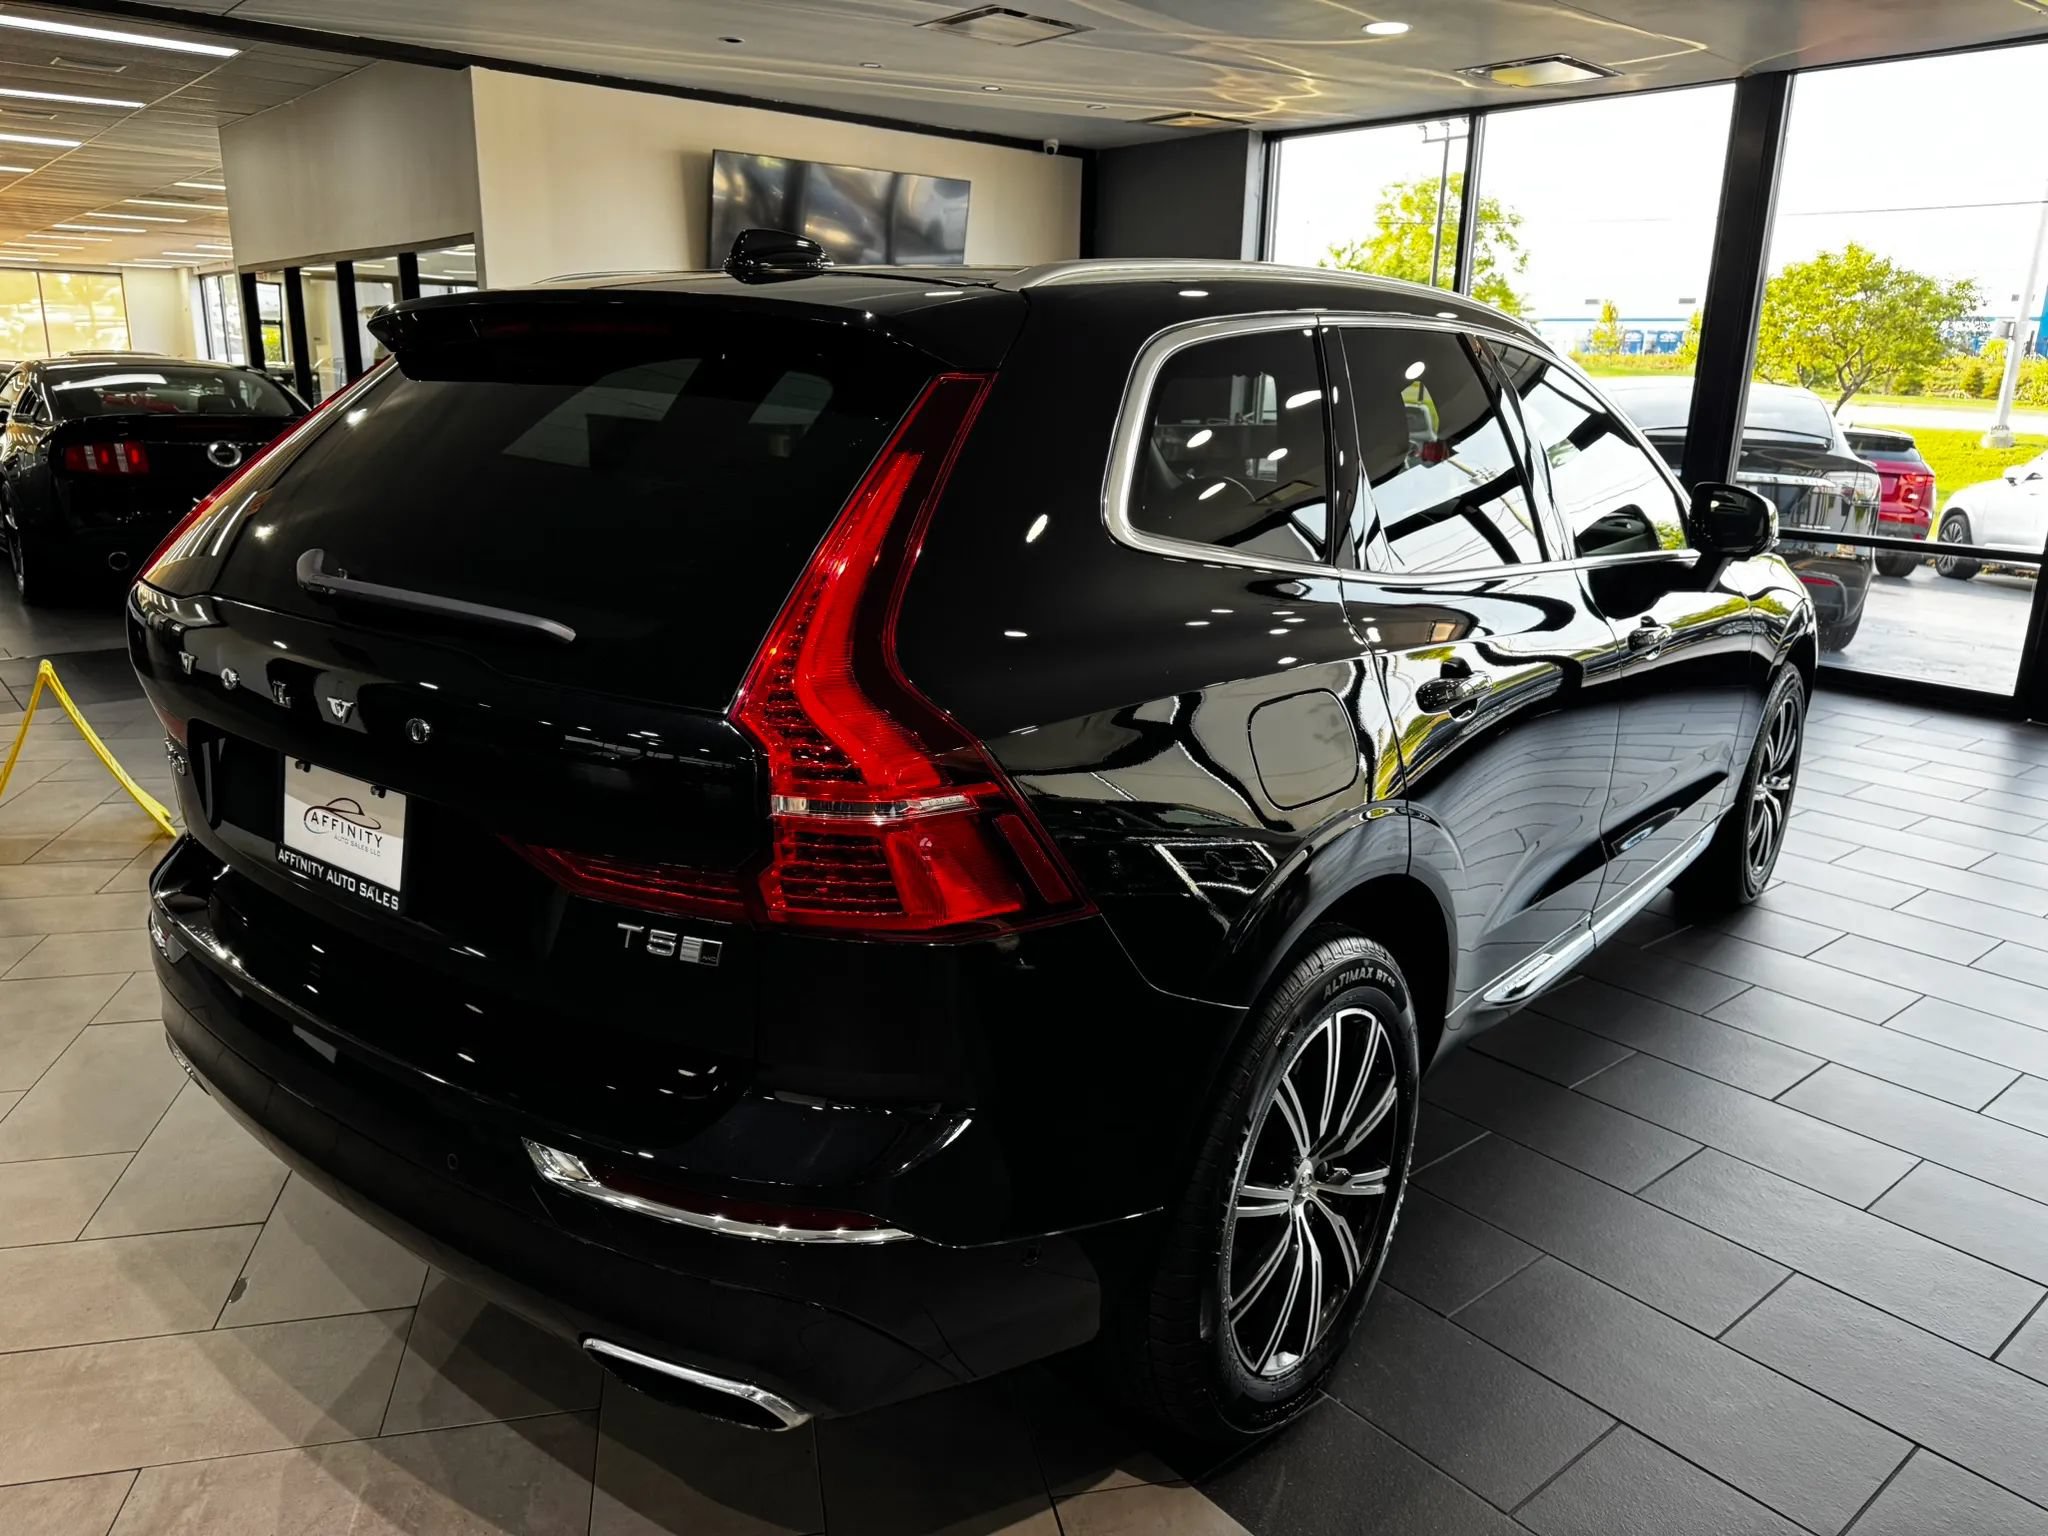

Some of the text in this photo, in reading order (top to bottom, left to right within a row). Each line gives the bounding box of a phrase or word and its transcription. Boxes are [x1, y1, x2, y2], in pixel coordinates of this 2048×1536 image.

[178, 650, 432, 744] VOLVO
[310, 811, 383, 848] AFFINITY
[278, 849, 399, 911] AFFINITY AUTO SALES
[617, 922, 678, 957] T5
[1323, 966, 1374, 1001] ALTIMAX
